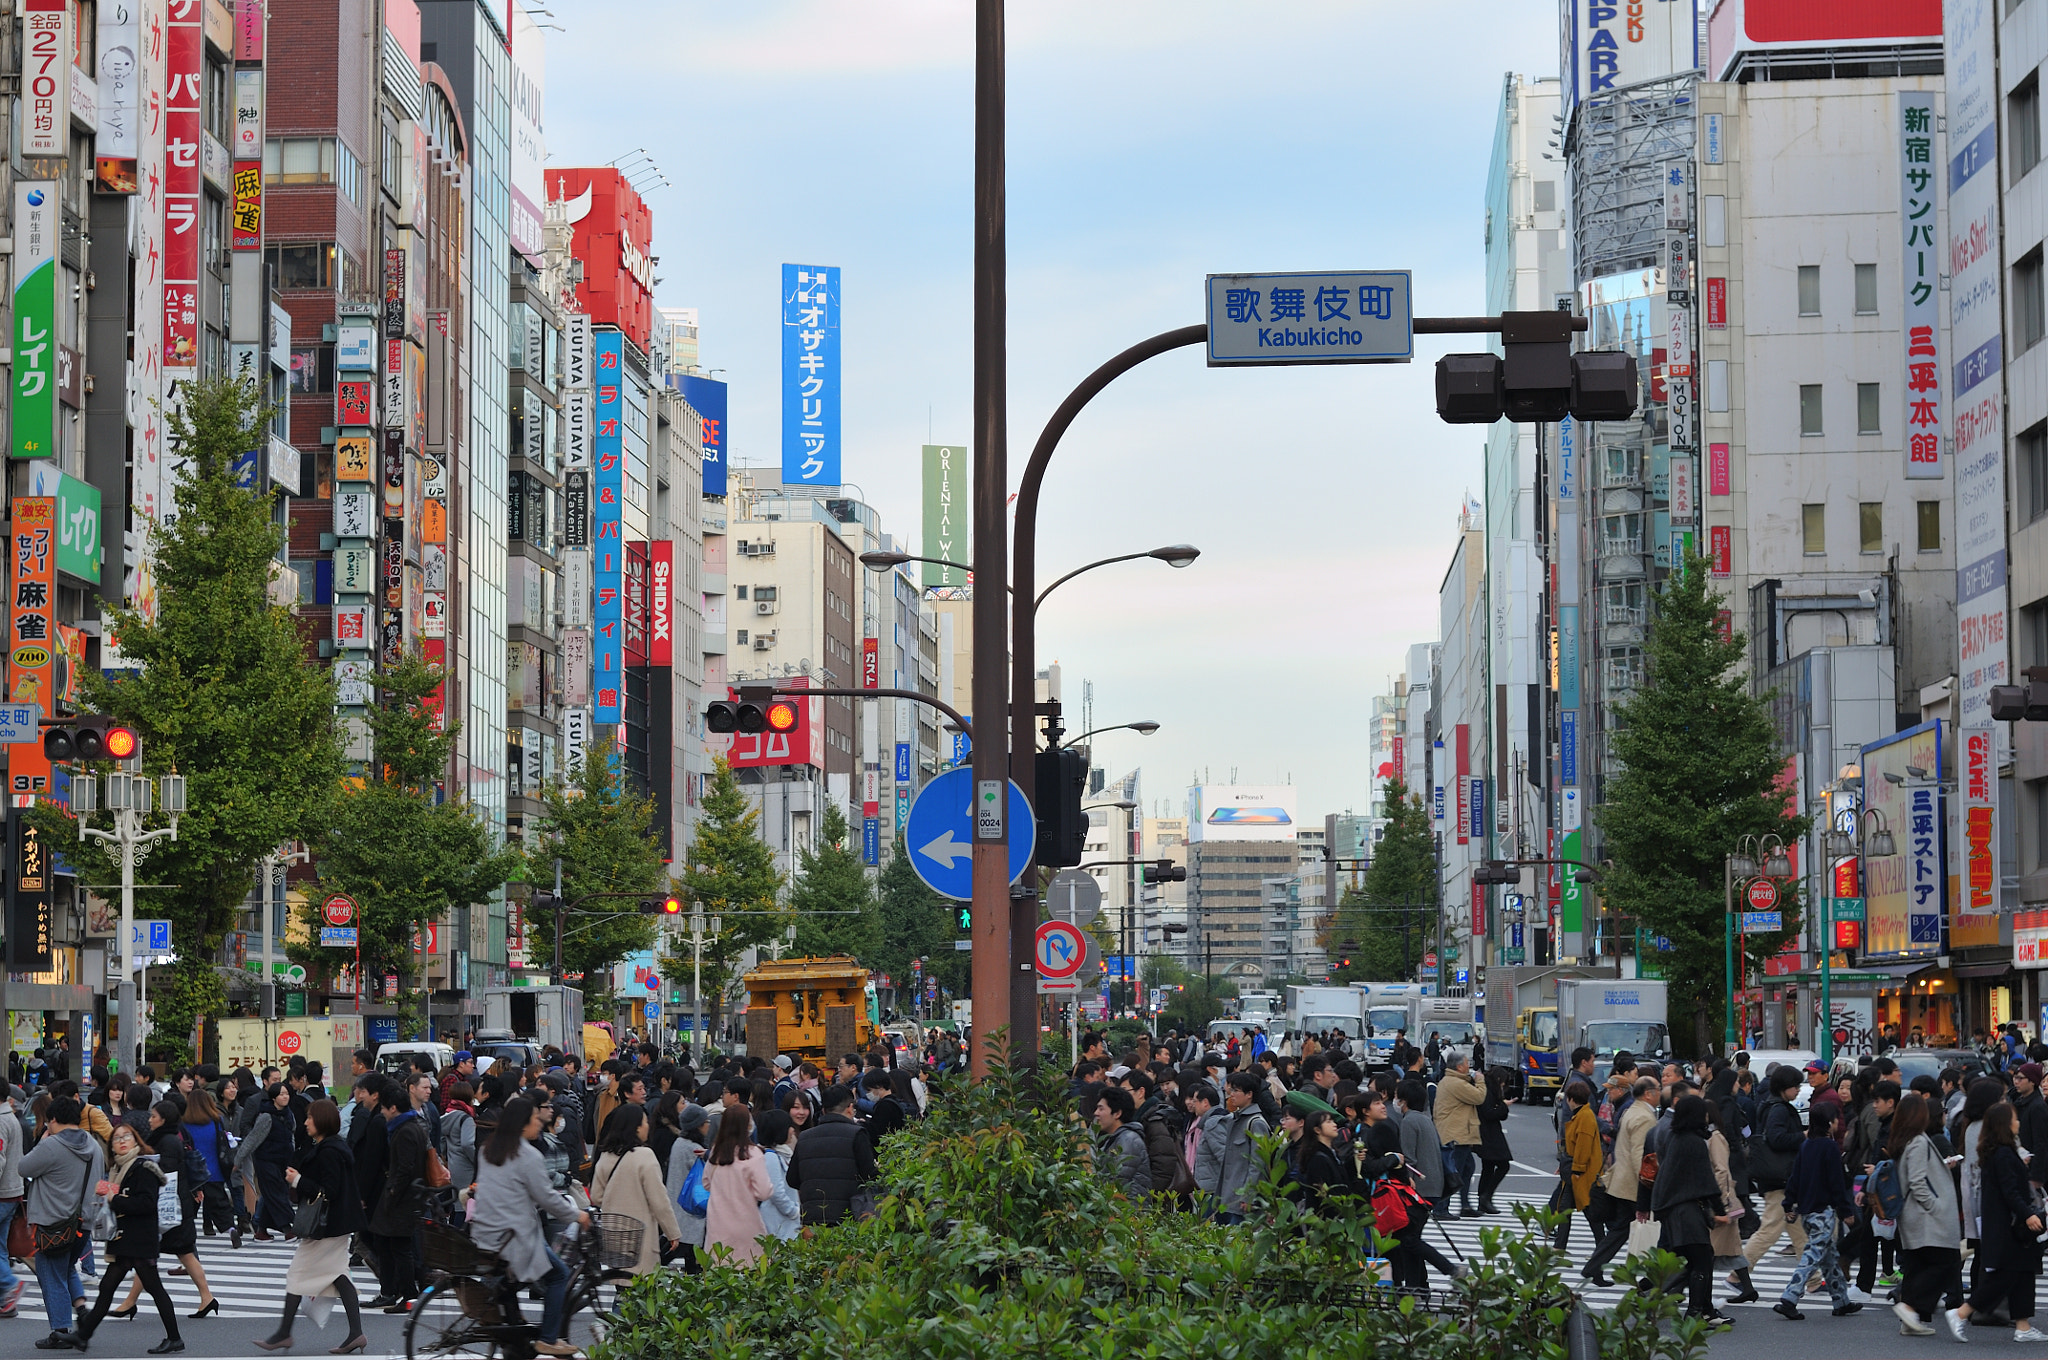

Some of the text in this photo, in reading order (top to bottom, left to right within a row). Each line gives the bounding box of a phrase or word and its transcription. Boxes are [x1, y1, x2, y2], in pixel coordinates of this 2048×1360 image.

[30, 14, 62, 30] 全品
[513, 62, 543, 135] KAIUL
[167, 73, 200, 235] パセラ
[1963, 141, 1978, 177] 4F
[234, 168, 261, 232] 麻雀
[30, 211, 41, 256] 新生銀行
[1952, 234, 1968, 278] Nice
[1671, 292, 1685, 300] 6F
[1905, 107, 1938, 463] 新宿サンパーク 三平本館
[182, 293, 196, 325] 名物
[1225, 286, 1393, 323] 歌舞伎町
[571, 318, 583, 384] TSUTAYA
[1258, 327, 1363, 348] Kabukicho
[20, 317, 47, 396] レイク
[1672, 366, 1688, 374] 5F
[800, 306, 824, 480] オザキクリニック
[571, 397, 583, 463] TSUTAYA
[1673, 384, 1687, 445] MOUTON
[24, 441, 39, 451] 4F
[21, 504, 48, 517] 激安
[577, 491, 585, 509] Hair
[940, 447, 951, 537] ORIENTAL
[61, 496, 97, 556] レイク
[18, 535, 32, 577] セット
[35, 529, 49, 573] フリー
[17, 581, 47, 641] 麻雀
[654, 561, 669, 641] SHIDAX
[17, 651, 45, 663] ZOO
[865, 652, 876, 685] ガスト
[14, 775, 46, 791] 3F
[1968, 735, 1984, 799] GAME
[980, 819, 1000, 827] 0024
[1912, 790, 1935, 906] 三平ストア
[329, 906, 351, 917] 消火栓
[1751, 890, 1774, 901] 消火栓
[1837, 900, 1861, 909] モア
[37, 901, 48, 954] わかめ無料
[155, 924, 165, 939] P
[2018, 944, 2035, 962] GAME
[1458, 971, 1466, 980] P
[680, 1032, 689, 1040] 13
